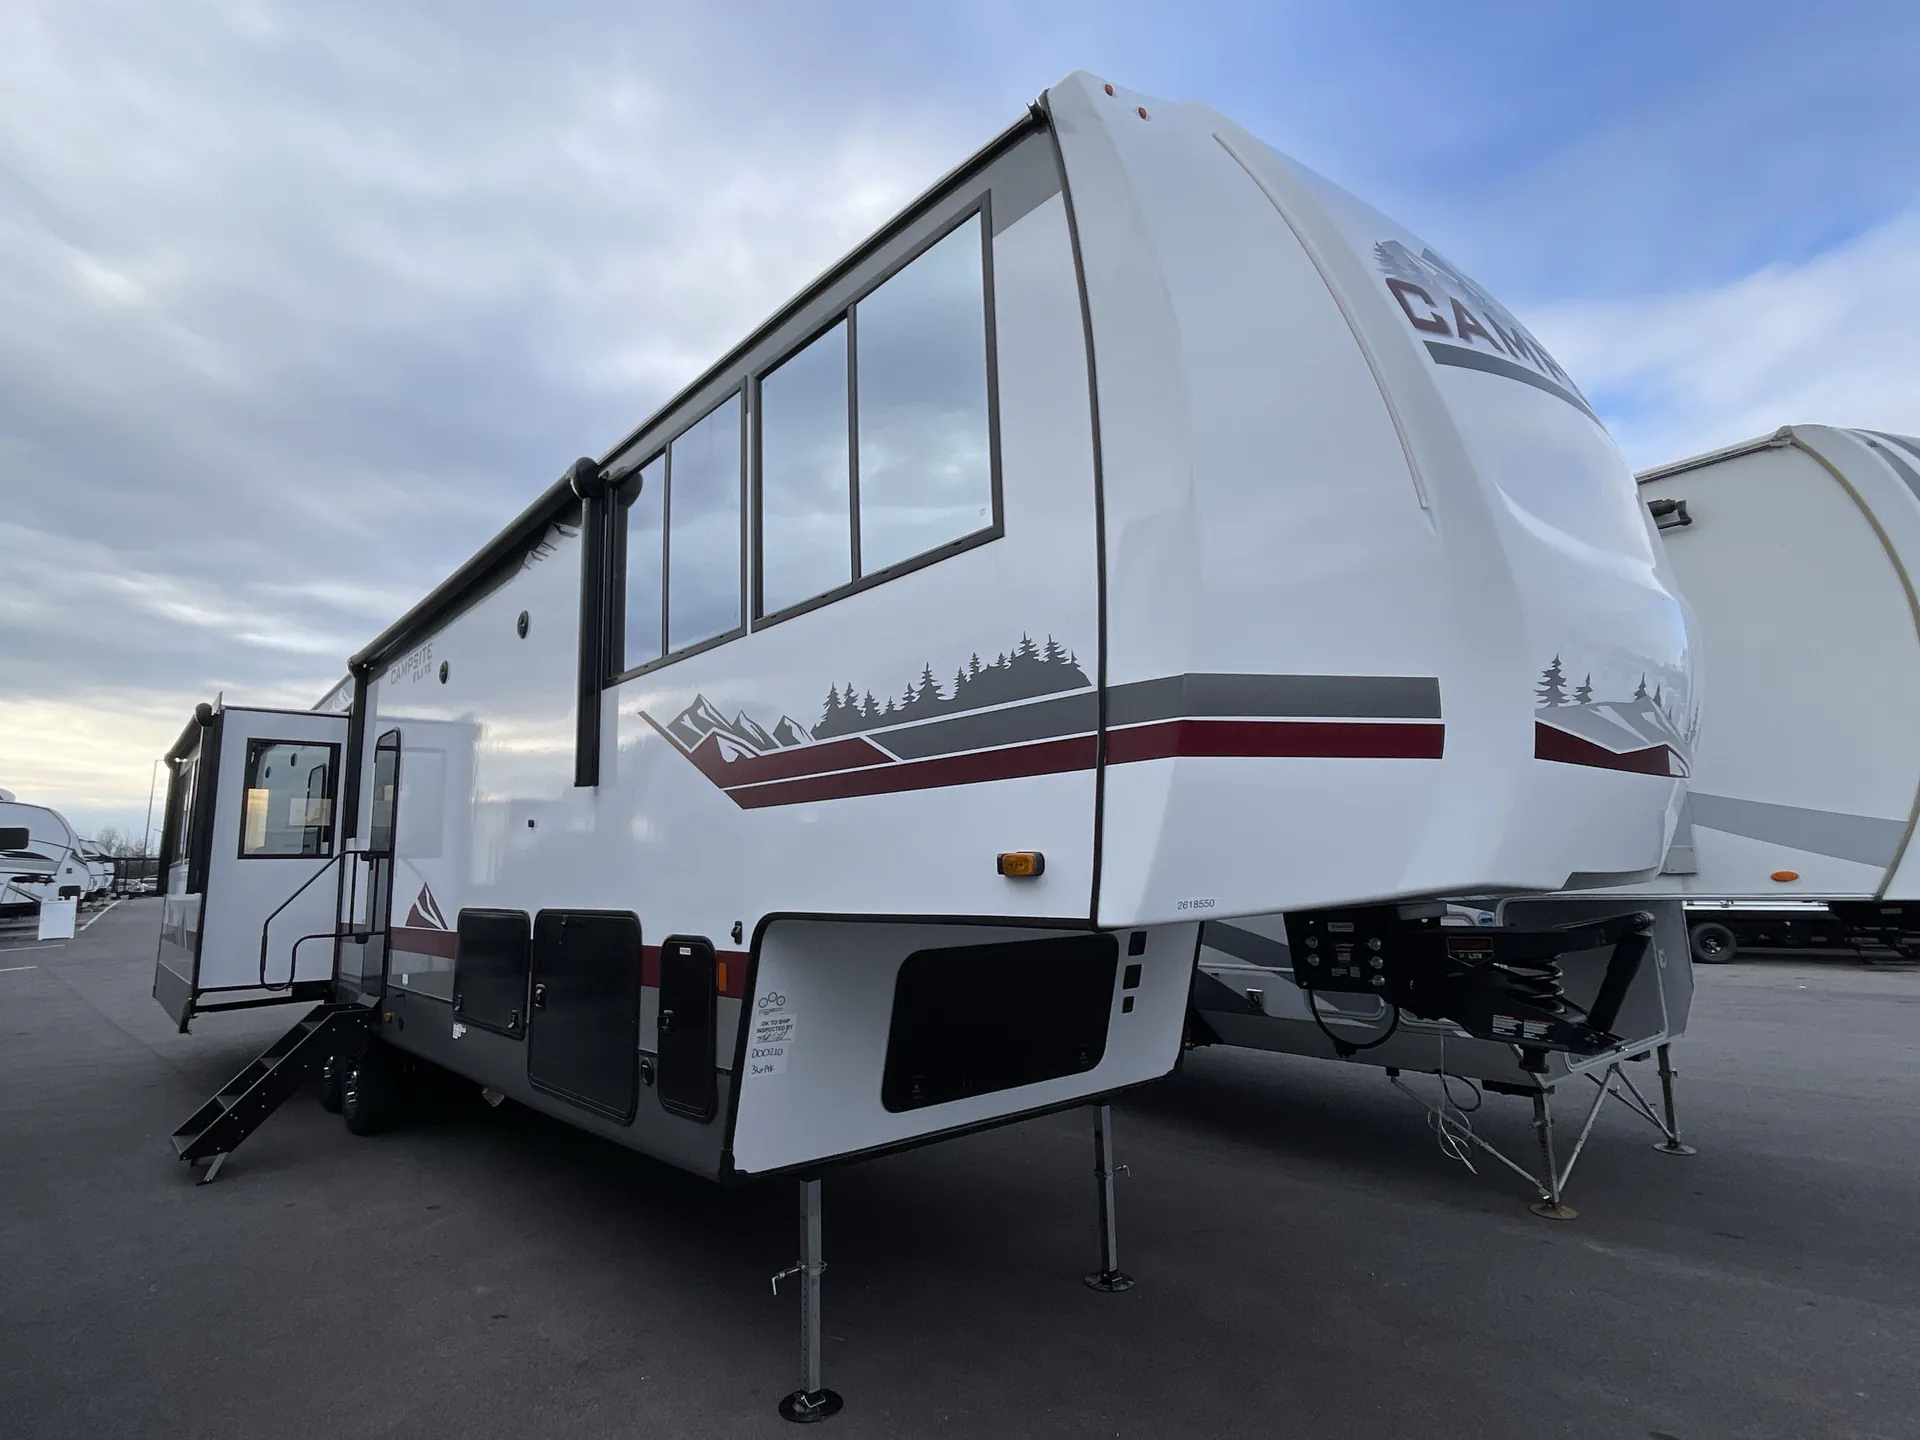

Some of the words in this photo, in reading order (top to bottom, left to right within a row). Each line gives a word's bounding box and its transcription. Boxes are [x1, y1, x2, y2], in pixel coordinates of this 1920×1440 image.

[391, 642, 434, 685] CAMPSITE
[412, 662, 433, 683] ELITE
[1177, 898, 1215, 910] 2618550
[756, 1025, 786, 1034] INSPECTED
